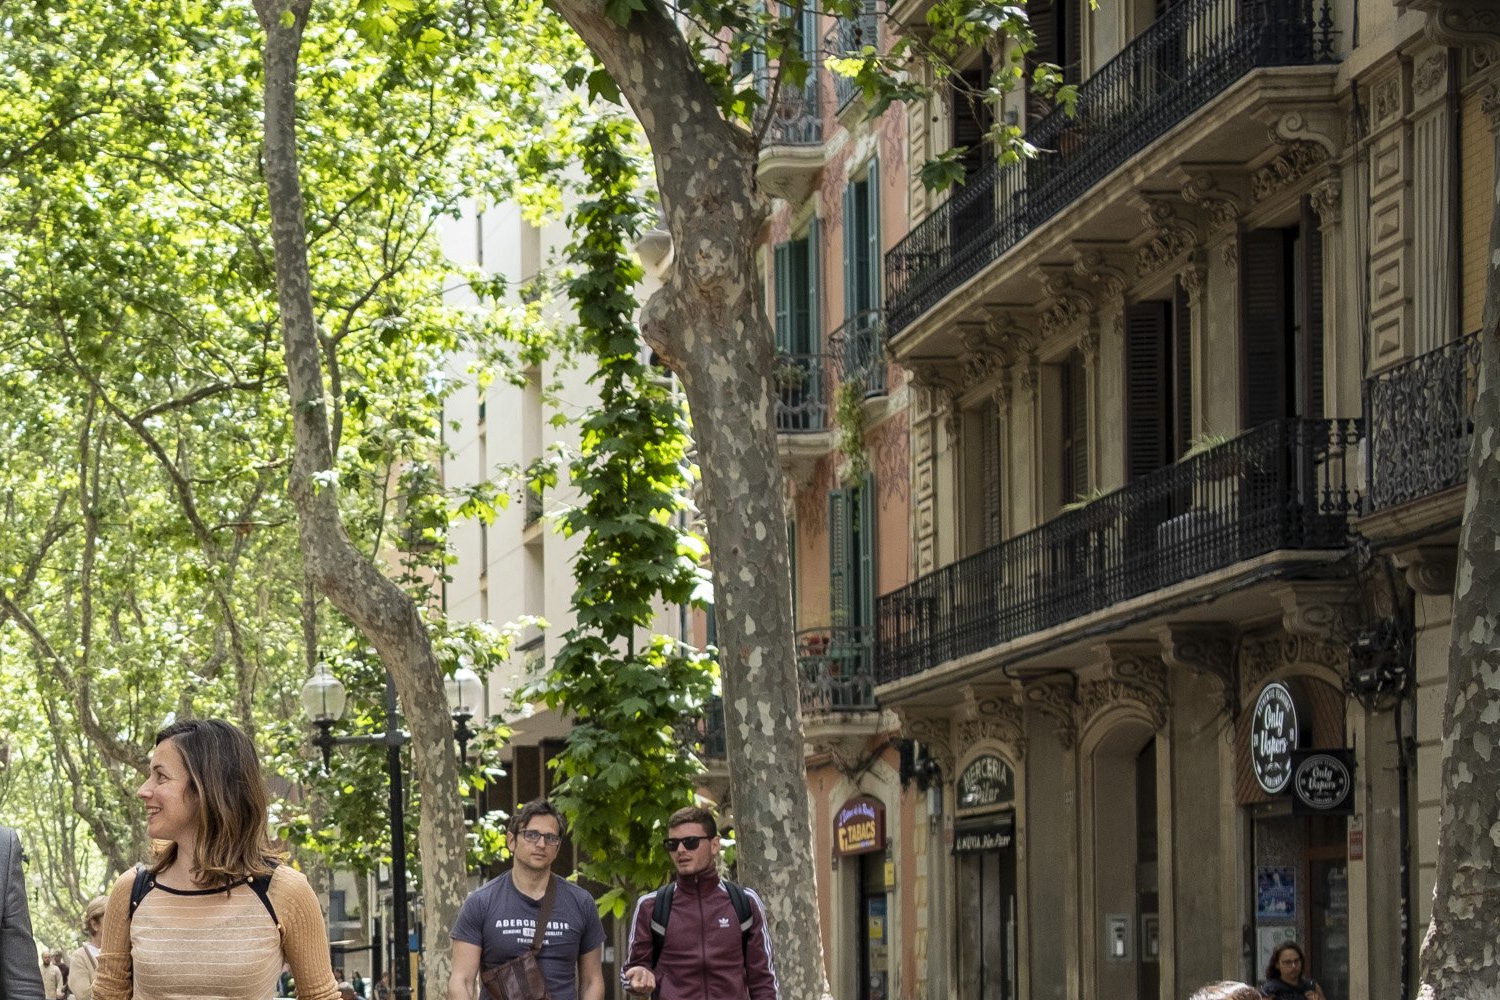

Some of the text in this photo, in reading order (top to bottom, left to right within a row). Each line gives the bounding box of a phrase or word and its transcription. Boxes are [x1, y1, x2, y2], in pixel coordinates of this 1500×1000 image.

[1265, 703, 1284, 738] Only
[1261, 729, 1288, 762] Vapers
[963, 757, 1007, 793] MERCERIA
[1308, 777, 1336, 792] Vapers
[1312, 766, 1333, 782] Only
[847, 820, 876, 843] TABACS
